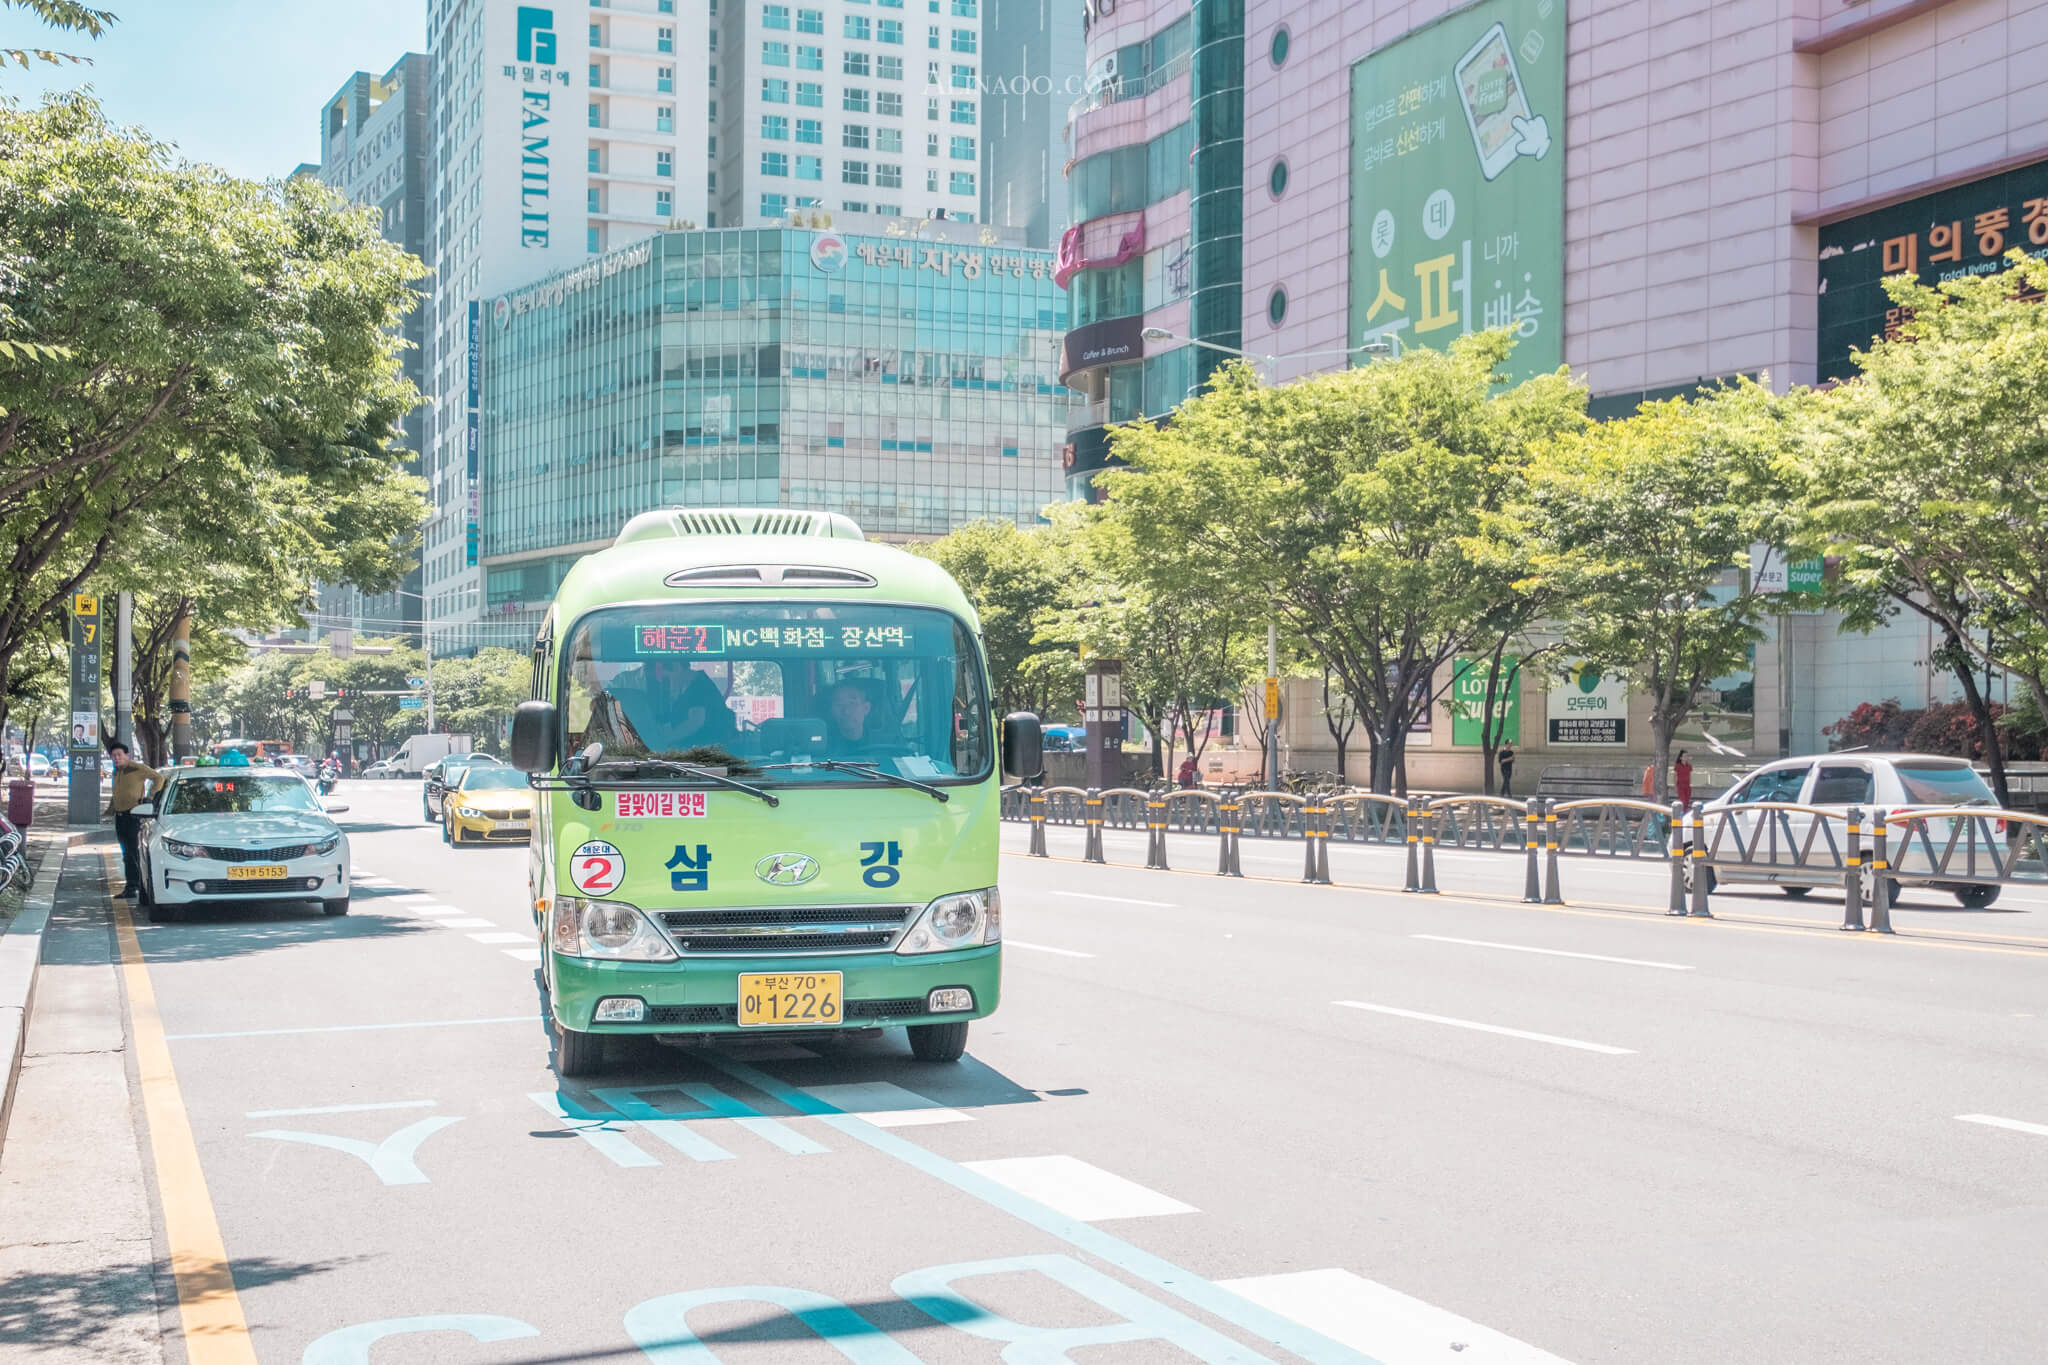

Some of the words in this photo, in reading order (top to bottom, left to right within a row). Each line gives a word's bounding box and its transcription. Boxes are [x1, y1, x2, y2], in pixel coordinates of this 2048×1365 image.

[503, 65, 570, 87] 파밀리에
[521, 88, 550, 248] FAMILIE
[856, 242, 913, 269] 해운대
[920, 248, 983, 281] 자생
[1484, 289, 1543, 338] 배송
[86, 624, 97, 643] 7
[641, 626, 708, 652] 해운2
[1567, 696, 1608, 711] 모두투어
[618, 793, 673, 817] 달맞이길
[678, 793, 705, 817] 방면
[582, 845, 611, 854] 해운대
[582, 857, 613, 889] 2
[664, 844, 712, 891] 삼
[860, 841, 903, 888] 강
[765, 977, 789, 990] 부산
[793, 976, 816, 990] 70
[768, 992, 836, 1019] 1226
